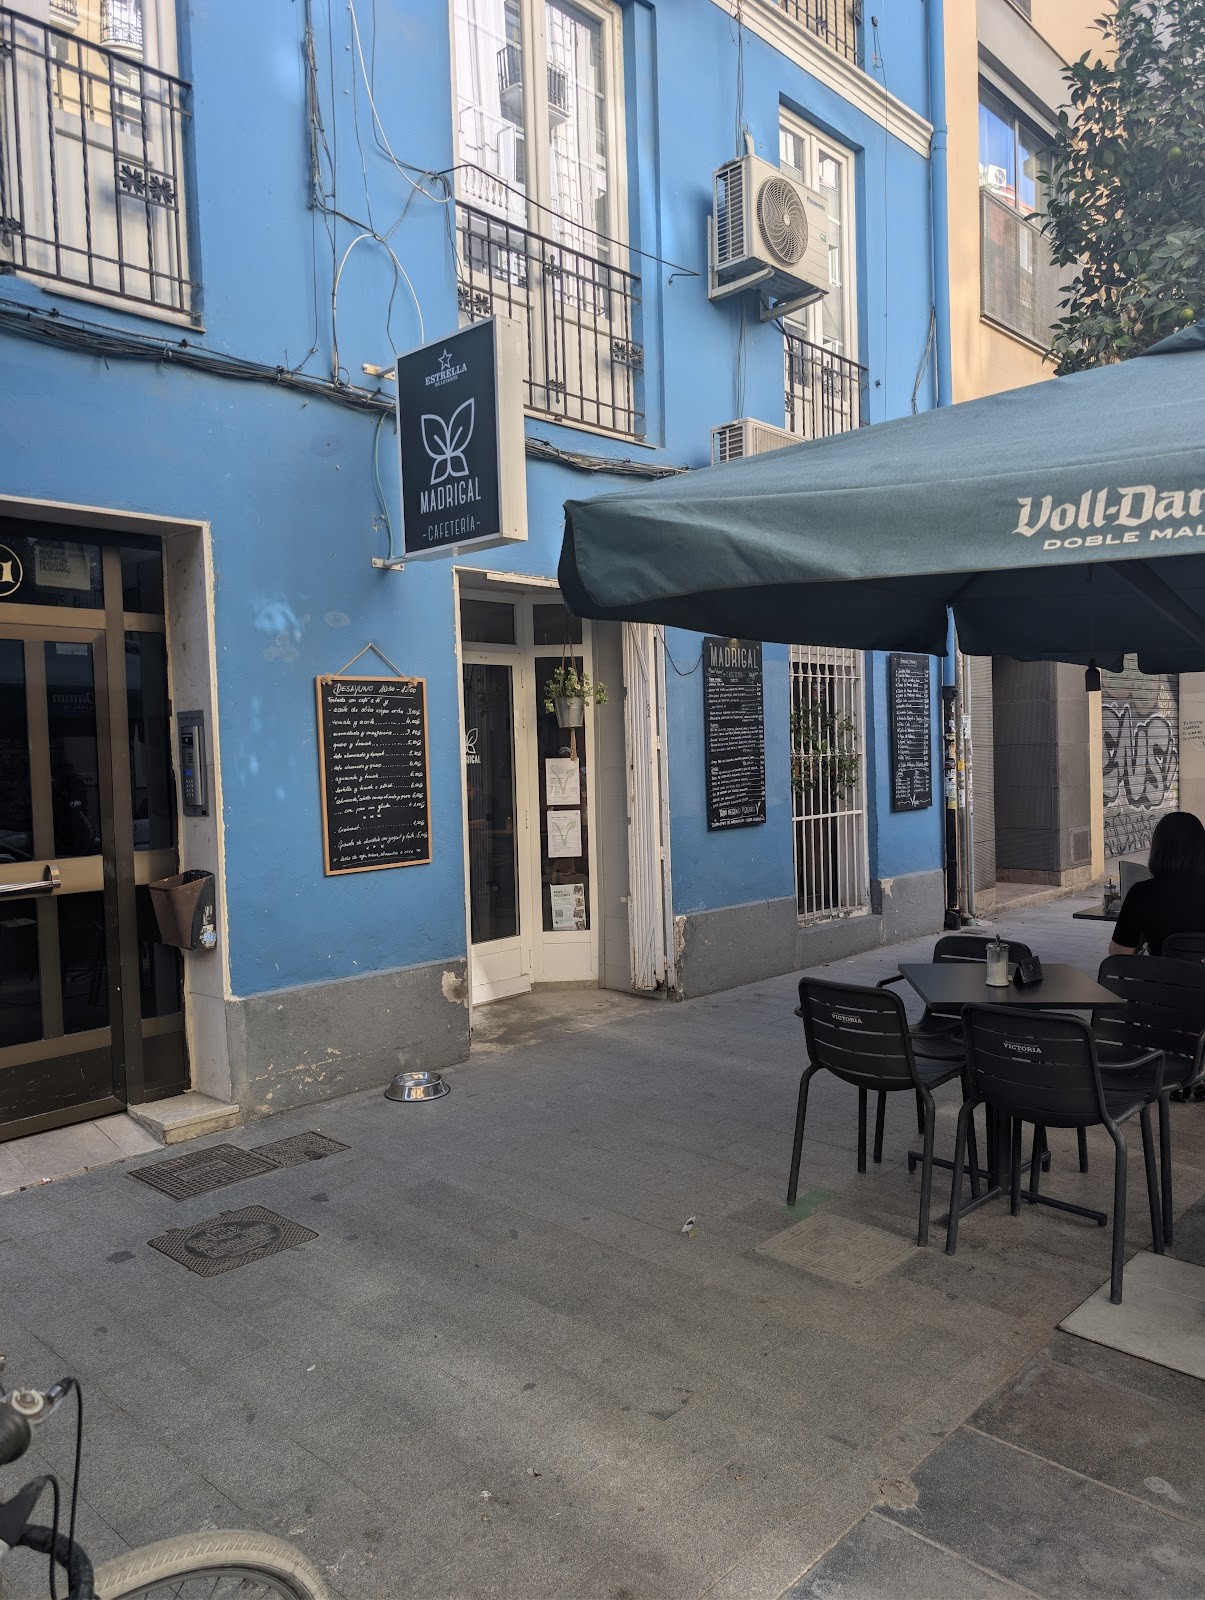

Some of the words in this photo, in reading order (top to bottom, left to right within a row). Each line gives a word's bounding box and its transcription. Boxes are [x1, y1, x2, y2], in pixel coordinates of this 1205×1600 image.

[425, 363, 467, 386] ESTRELLA
[420, 477, 482, 514] MADRIGAL
[1043, 531, 1141, 550] DOBLE
[710, 645, 759, 669] MADRIGAL
[333, 683, 374, 695] DESAYUNO
[831, 1013, 863, 1024] VICTORIA
[1003, 1042, 1042, 1053] VICTORIA
